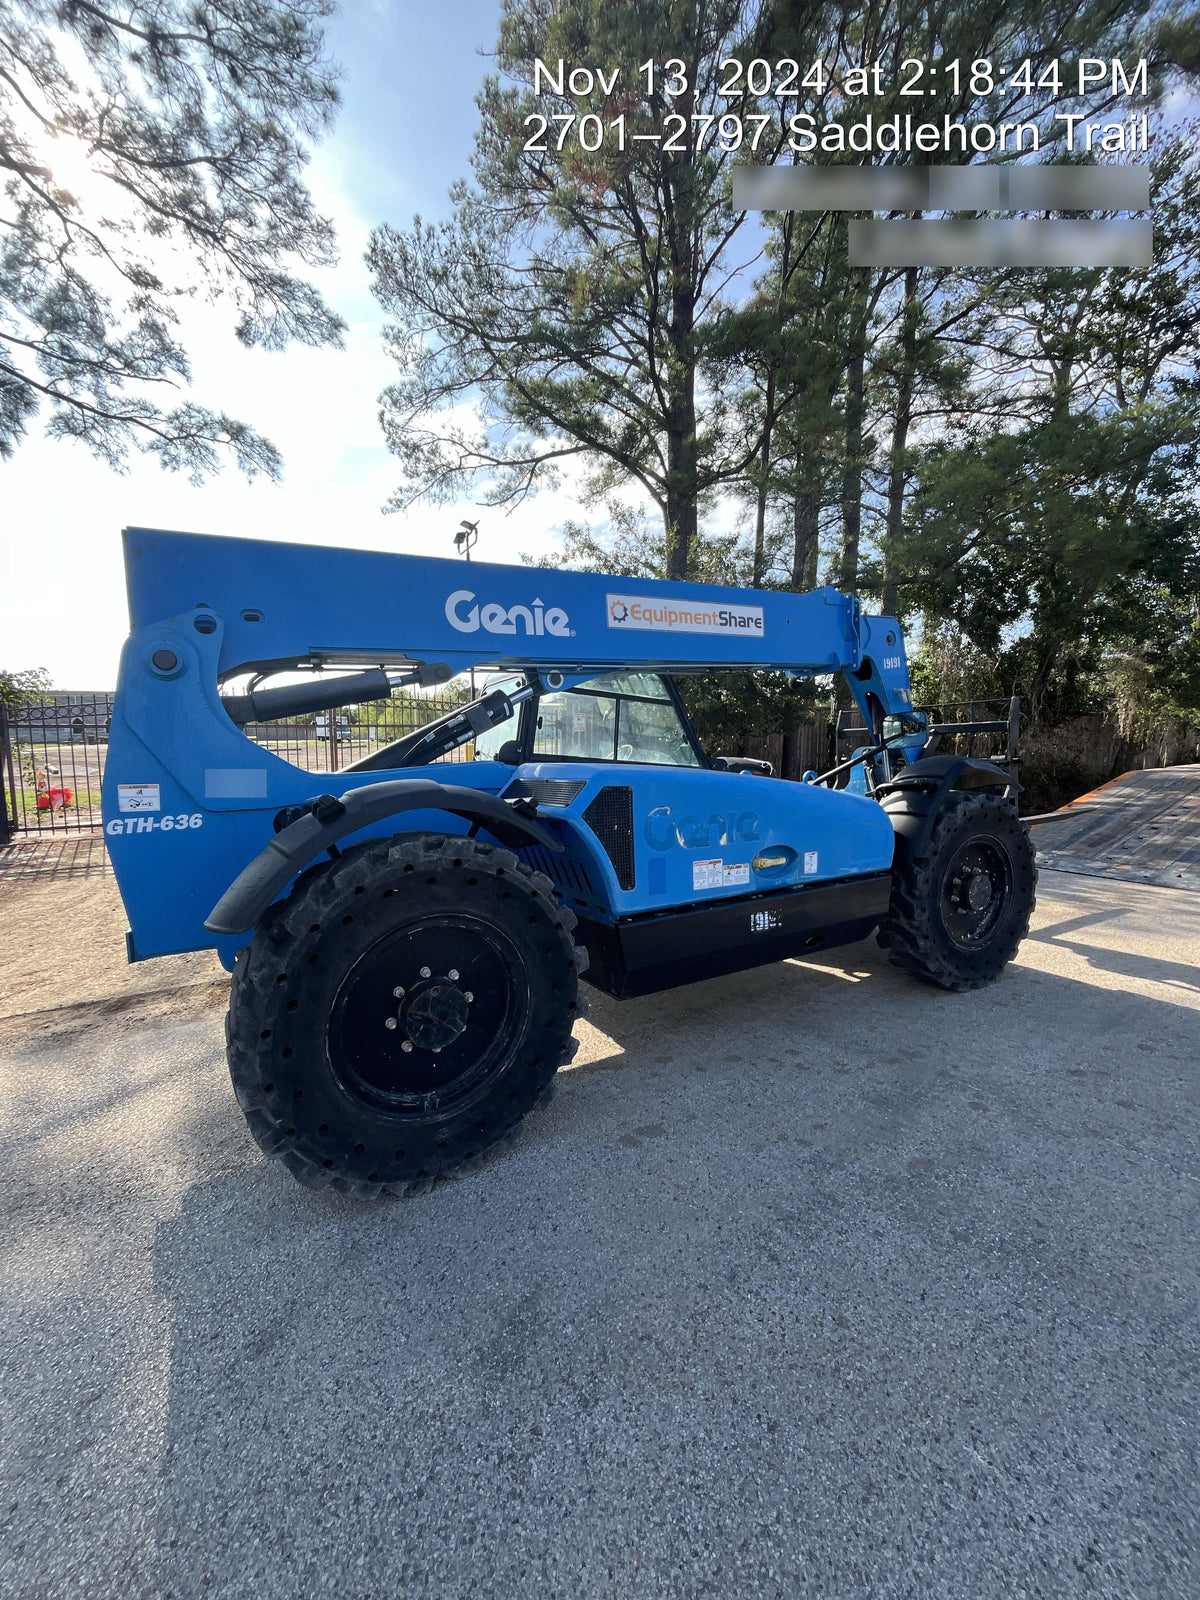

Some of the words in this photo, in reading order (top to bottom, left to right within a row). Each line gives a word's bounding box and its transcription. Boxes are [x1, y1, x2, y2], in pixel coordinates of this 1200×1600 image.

[445, 589, 570, 637] Genie
[630, 602, 763, 630] EquipmentShare
[883, 656, 901, 671] 19191
[106, 812, 204, 836] GTH-636
